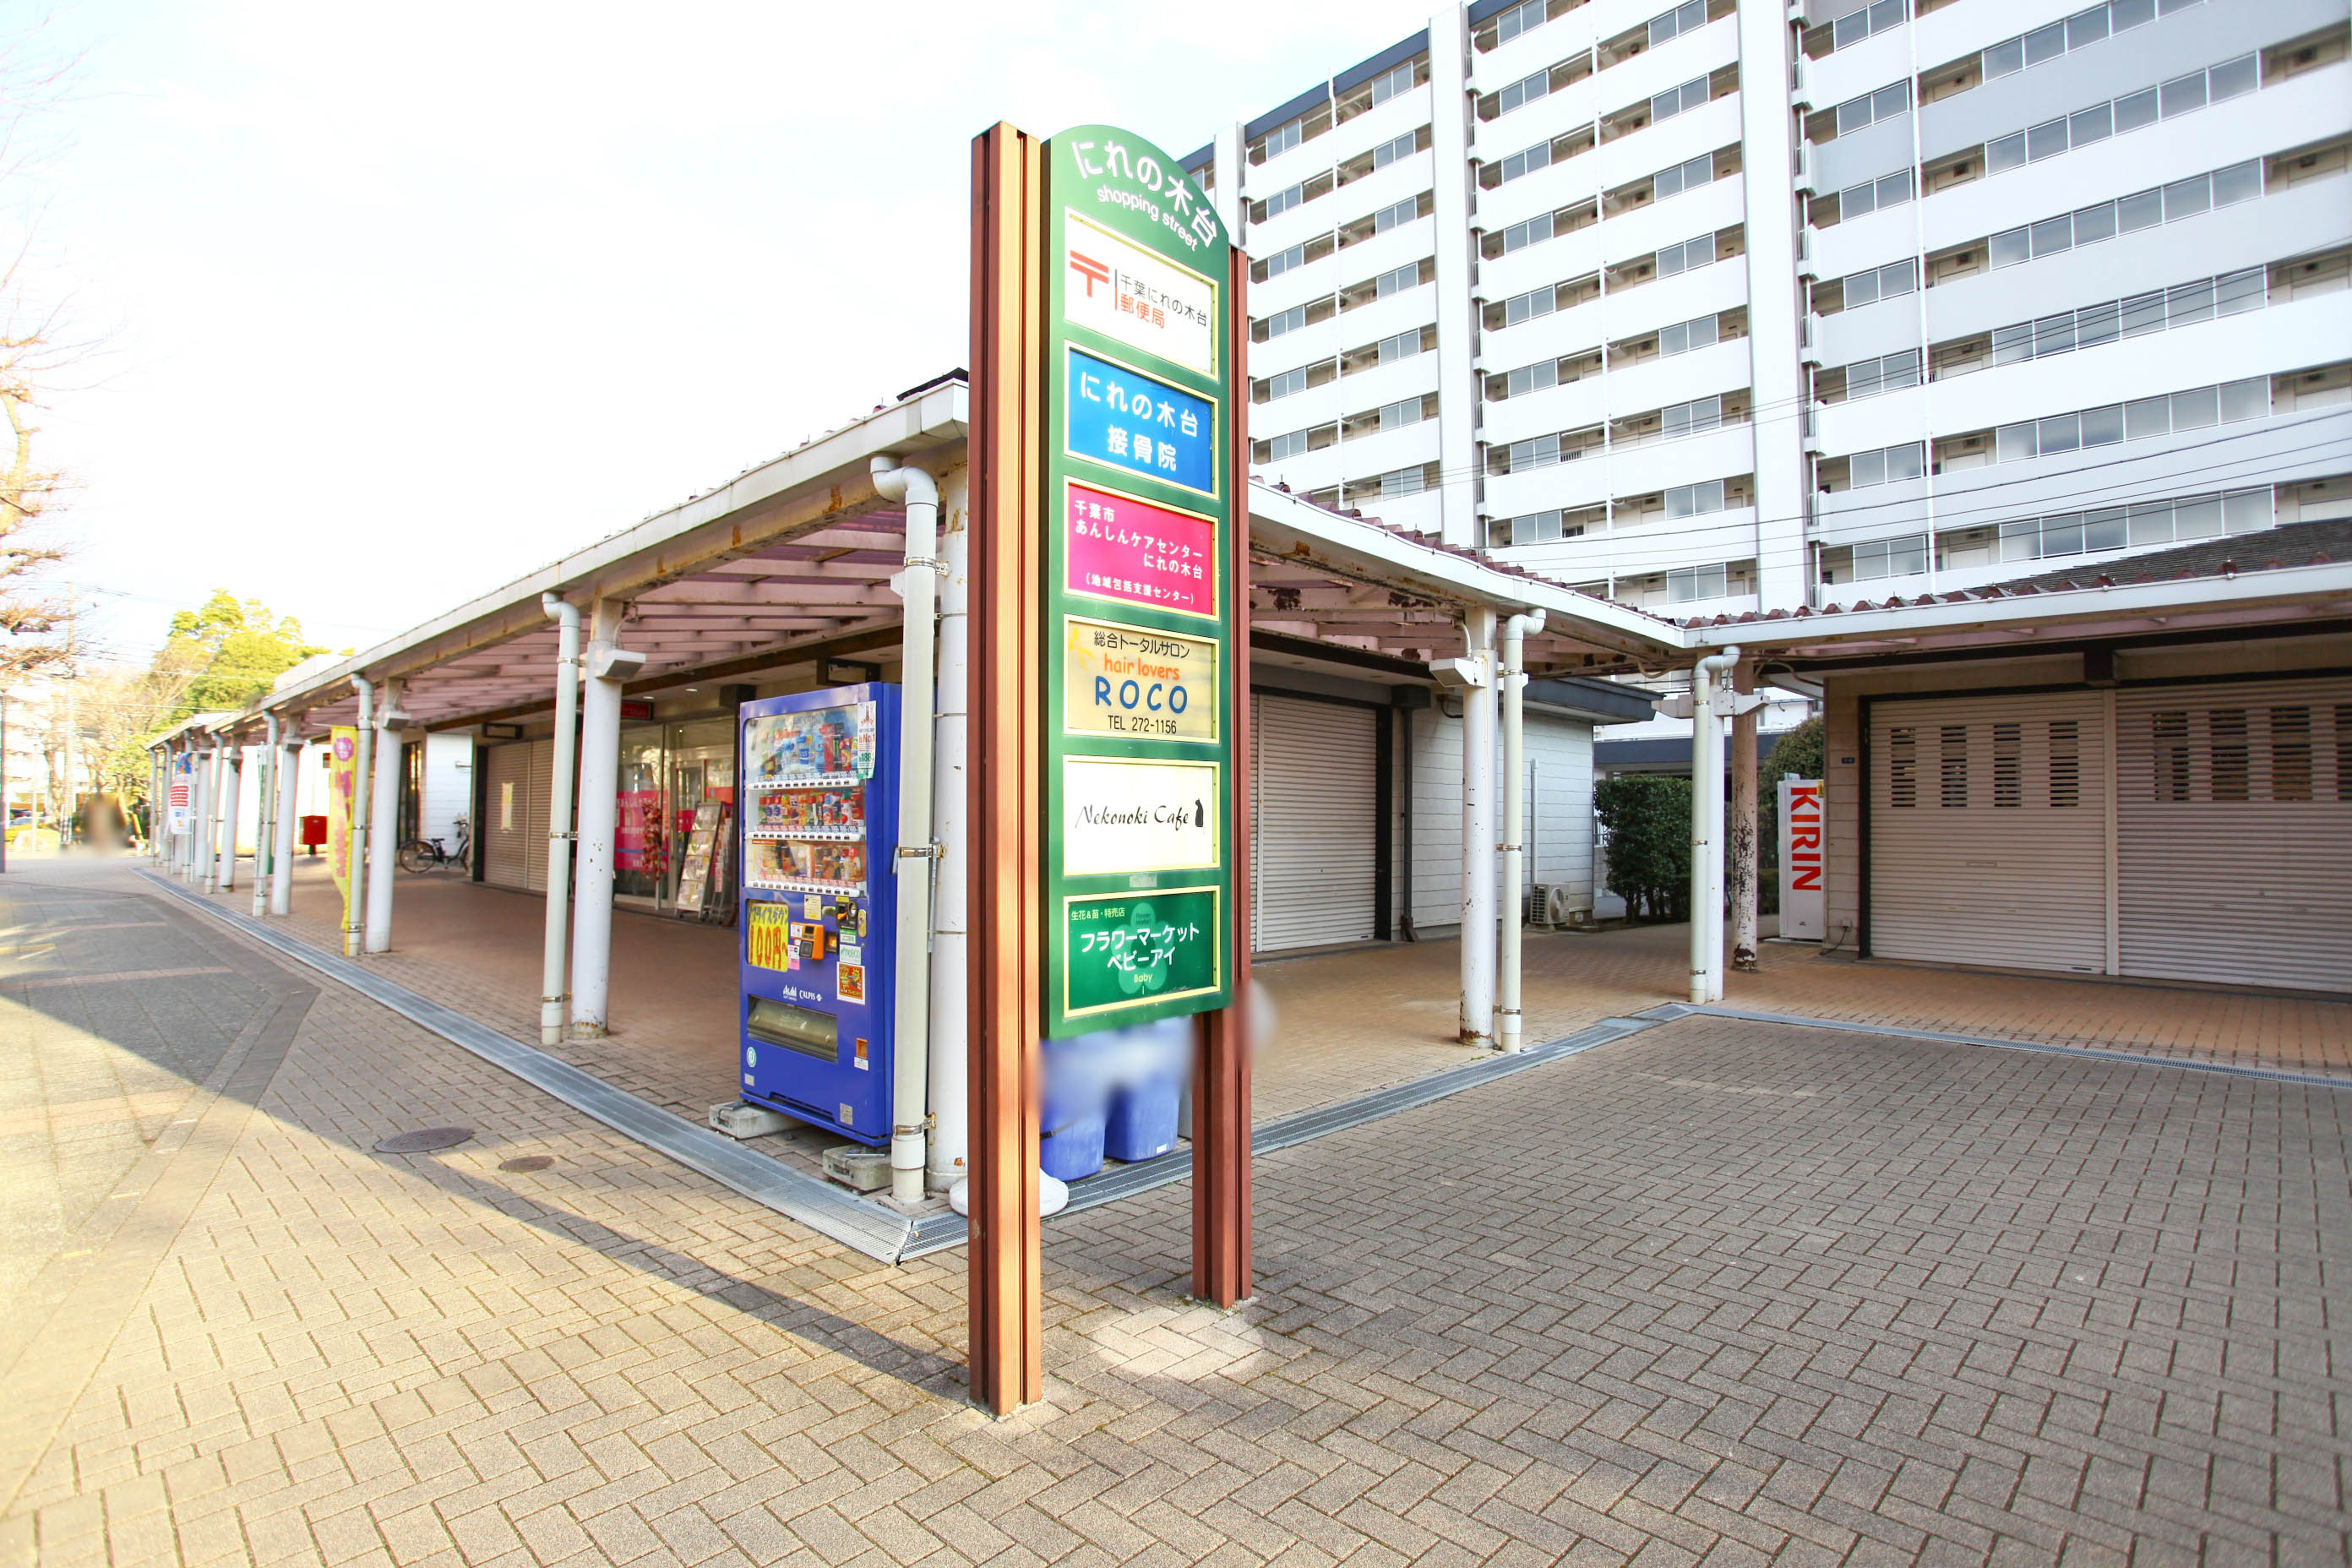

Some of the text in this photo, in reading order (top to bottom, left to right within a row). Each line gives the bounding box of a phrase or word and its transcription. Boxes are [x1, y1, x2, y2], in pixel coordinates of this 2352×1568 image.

[1072, 140, 1217, 248] にれの木台
[1097, 184, 1198, 252] shopping street
[1120, 274, 1207, 327] 千葉にれの木台
[1120, 293, 1165, 329] 郵便局
[1081, 372, 1199, 438] にれの木台
[1108, 424, 1177, 471] 接骨院
[1075, 499, 1115, 522] 千葉市
[1075, 519, 1203, 558] あんしんケアセンター
[1144, 553, 1203, 580] にれの木台
[1094, 630, 1190, 658] 総合トータルサロン
[1104, 653, 1180, 681] hair lovers
[1095, 675, 1188, 714] ROCO
[1108, 715, 1177, 734] TEL 272-1156
[1075, 804, 1189, 831] Nekonoki Cafe
[1790, 787, 1821, 891] KIRIN
[1081, 922, 1200, 953] フラワーマーケット
[1134, 973, 1152, 983] Baby
